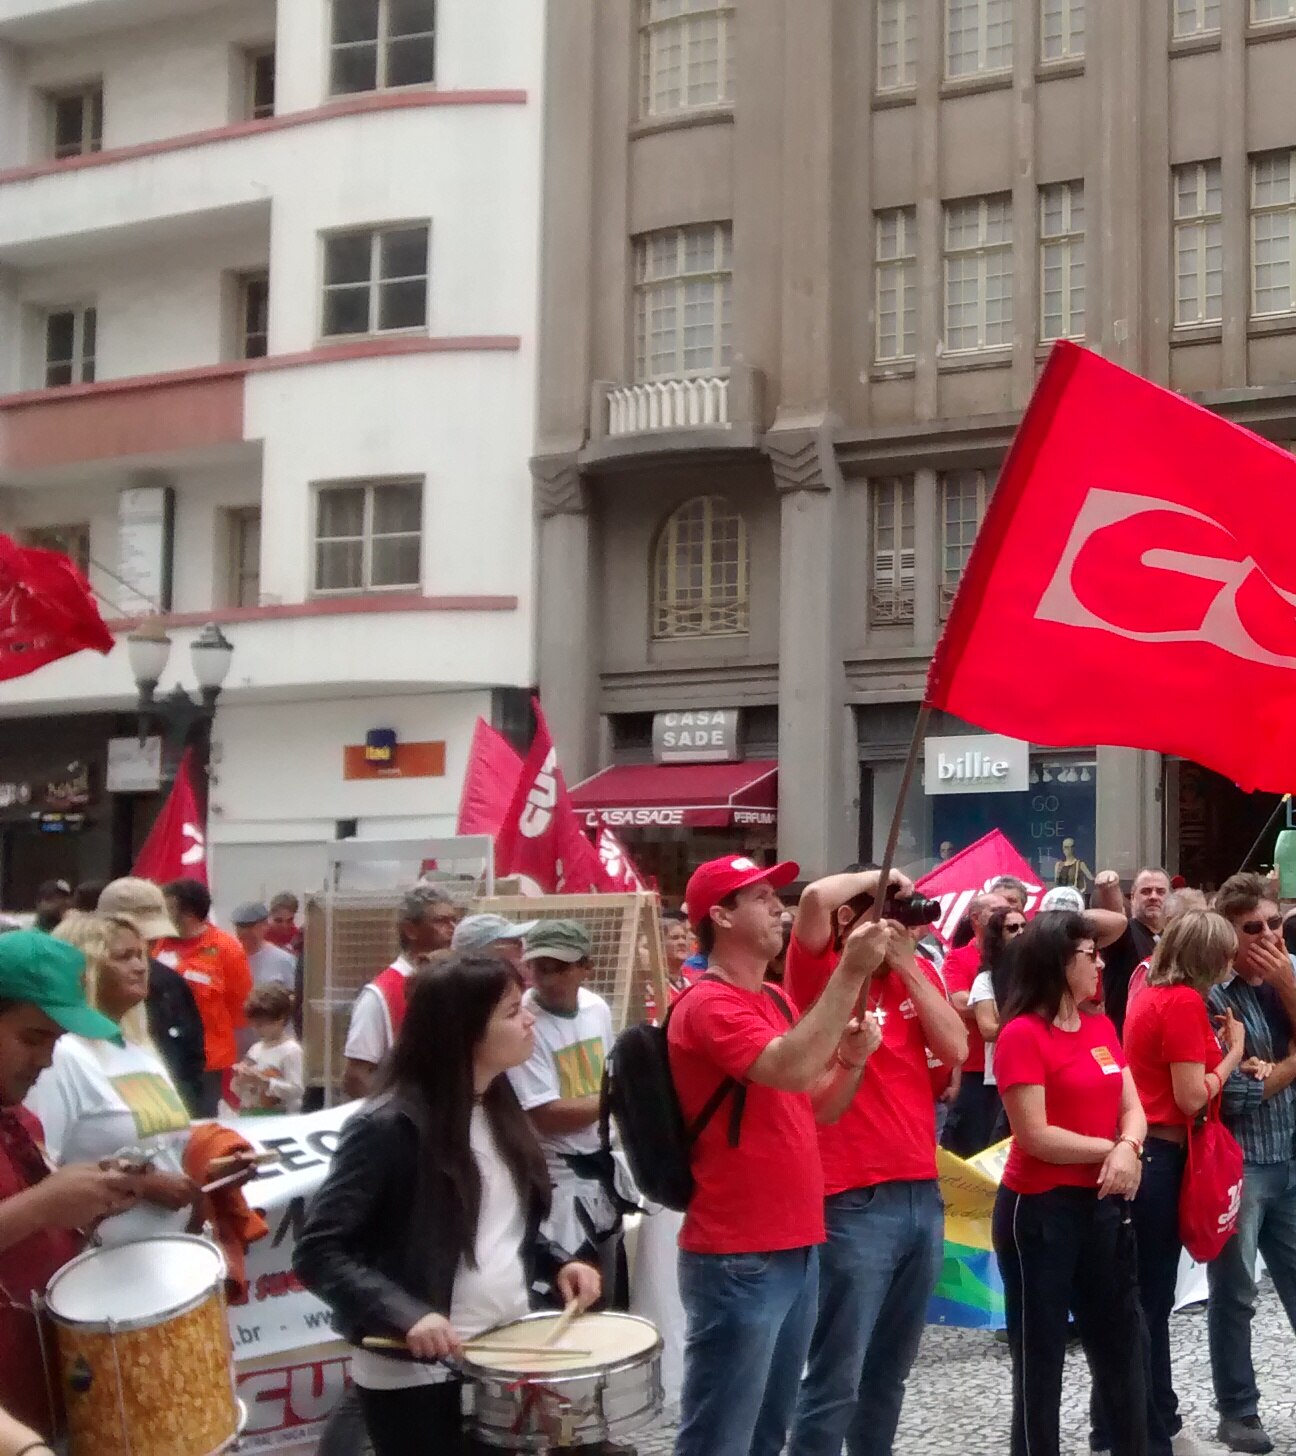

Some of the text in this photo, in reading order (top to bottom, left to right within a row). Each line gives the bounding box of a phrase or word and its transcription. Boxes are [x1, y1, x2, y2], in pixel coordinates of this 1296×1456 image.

[663, 711, 726, 728] CASA
[662, 730, 724, 747] SADE
[938, 751, 1009, 780] billie
[1032, 795, 1060, 813] GO
[1031, 820, 1065, 839] USE
